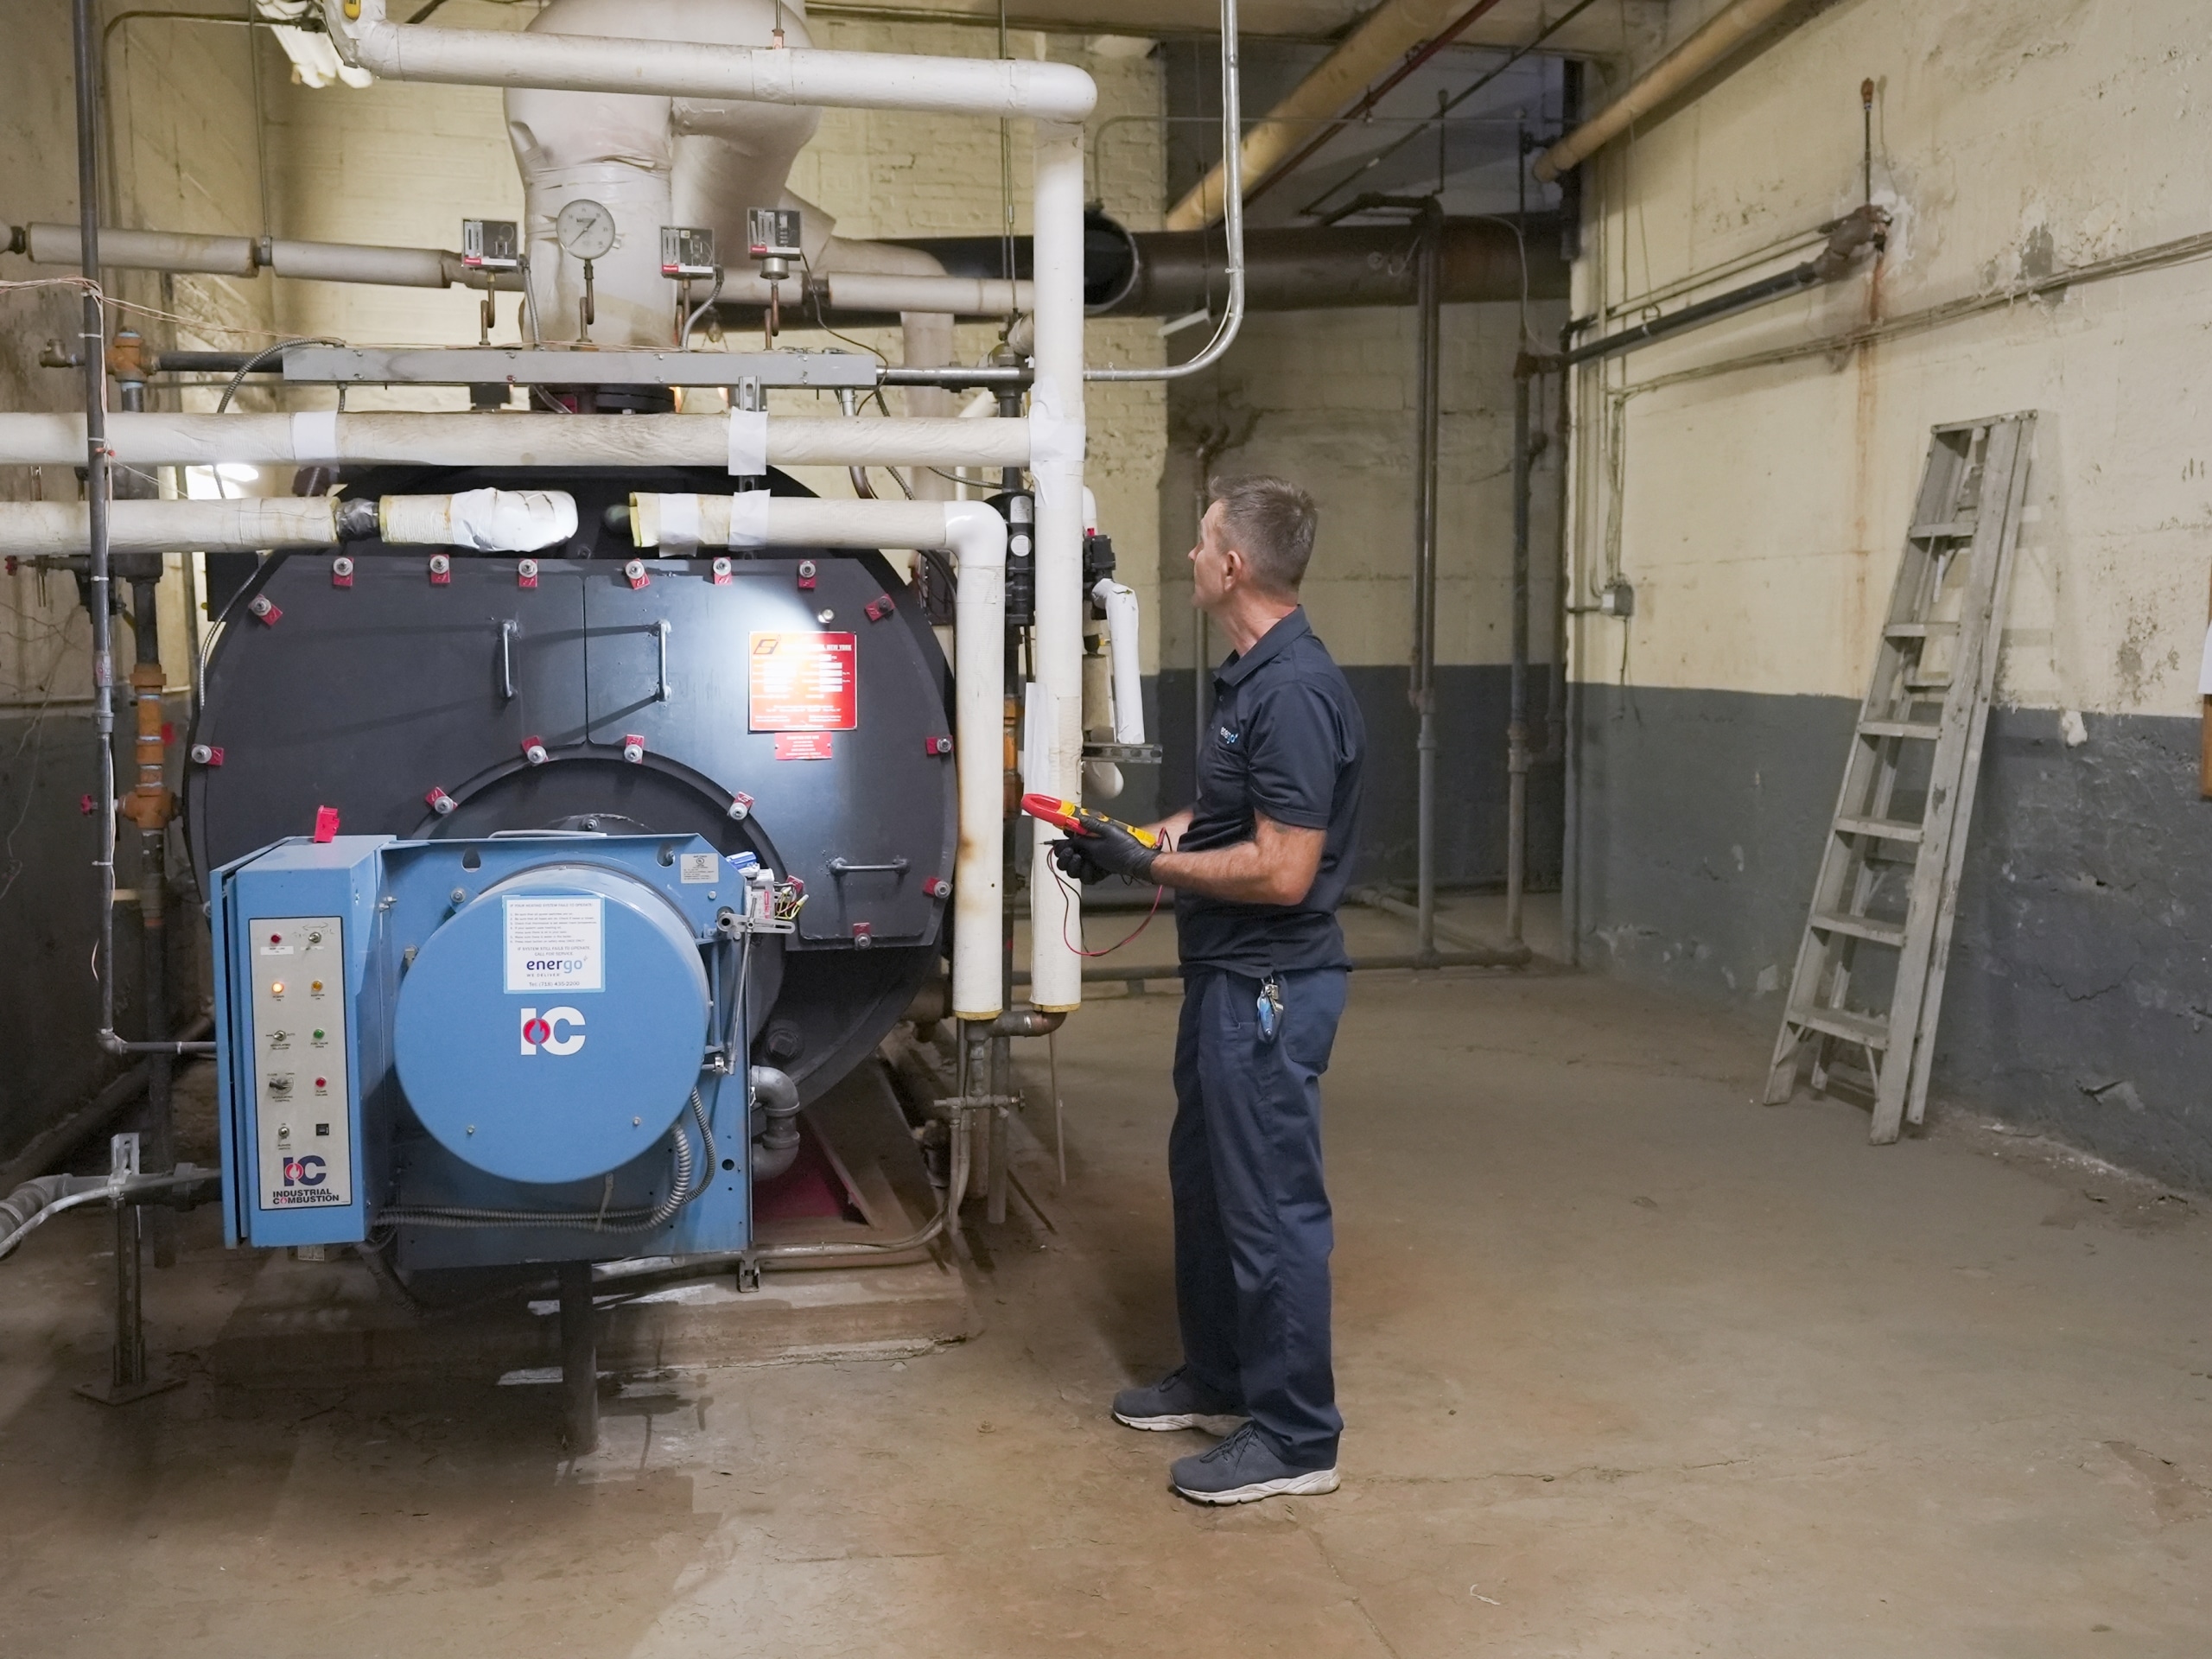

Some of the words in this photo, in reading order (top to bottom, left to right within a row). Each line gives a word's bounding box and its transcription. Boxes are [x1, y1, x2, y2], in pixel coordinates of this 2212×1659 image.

[526, 960, 583, 974] energo
[520, 1006, 586, 1056] IC
[283, 1154, 327, 1187] IC
[272, 1188, 333, 1198] INDUSTRIAL
[272, 1194, 340, 1205] COMBUSTION
